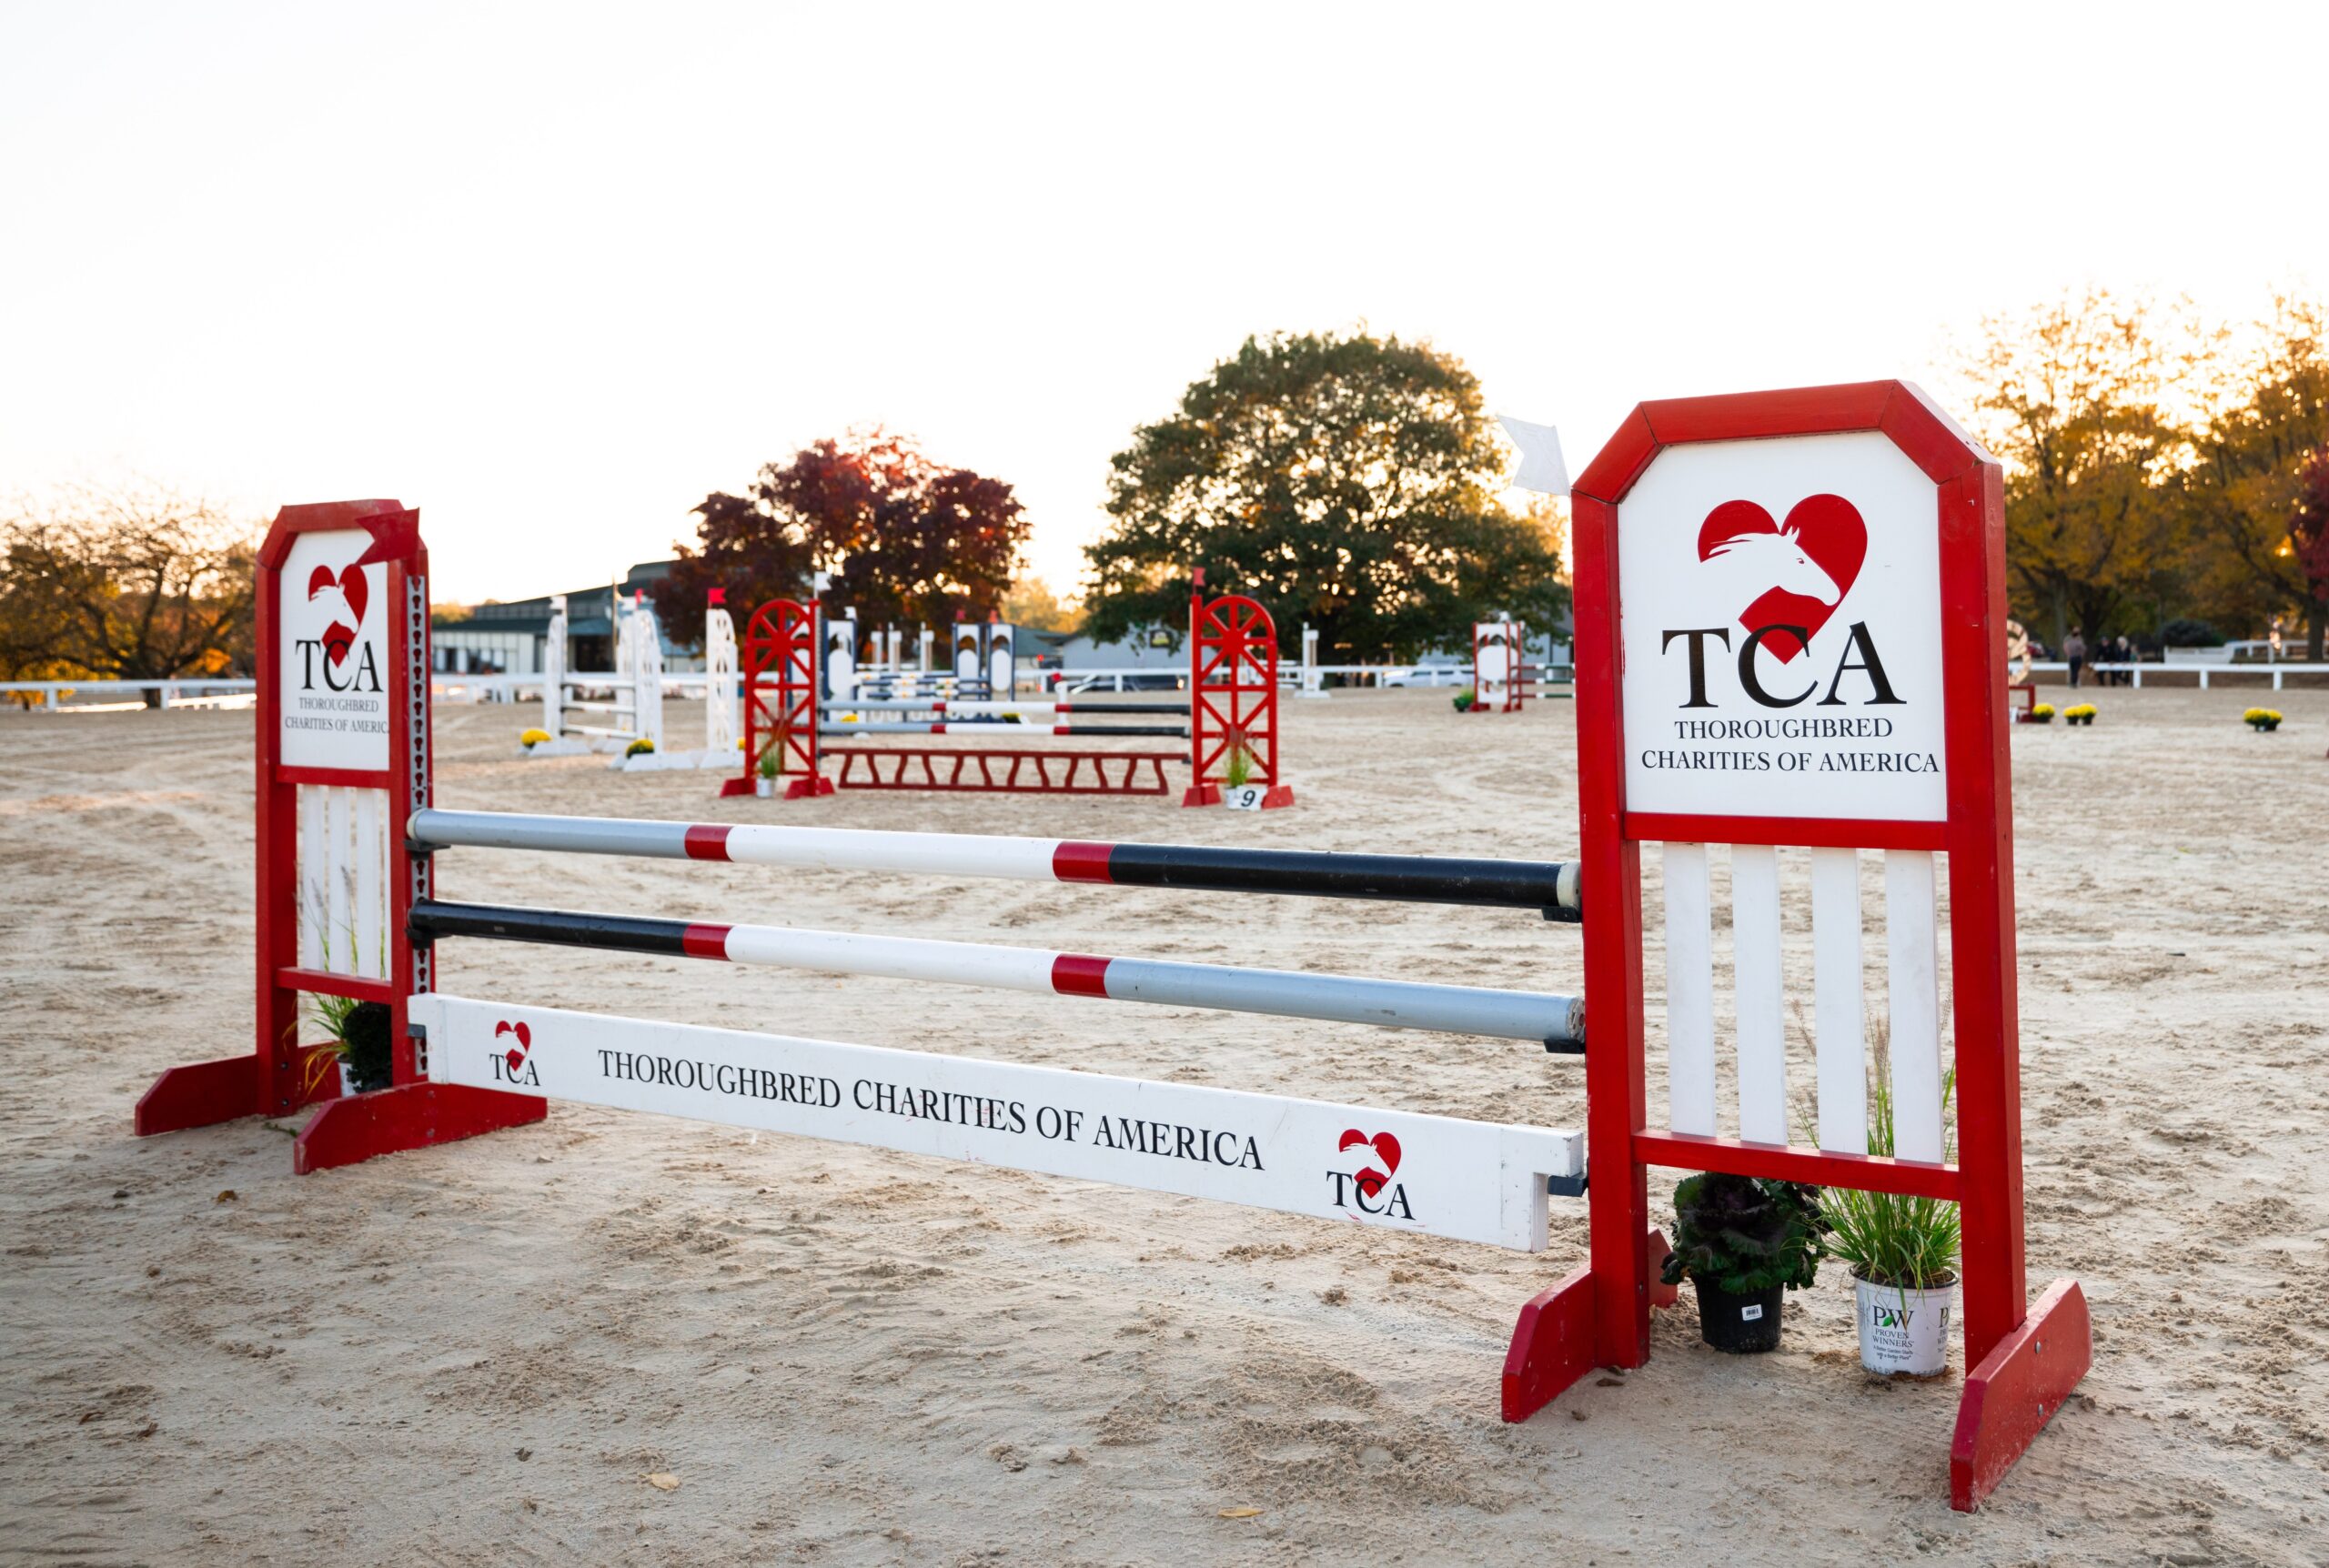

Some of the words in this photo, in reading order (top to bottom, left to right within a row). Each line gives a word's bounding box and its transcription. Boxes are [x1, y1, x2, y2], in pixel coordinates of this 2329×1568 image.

[296, 639, 384, 692] TCA
[1662, 621, 1907, 709] TCA
[298, 697, 379, 712] THOROUGHBRED
[285, 716, 333, 730] CHARITIES
[335, 719, 348, 731] OF
[350, 719, 389, 734] AMERIC
[1674, 718, 1892, 739] THOROUGHBRED
[1641, 750, 1770, 771] CHARITIES
[1777, 752, 1812, 772] OF
[1819, 752, 1940, 773] AMERICA
[1241, 789, 1256, 808] 9
[489, 1053, 540, 1086] TCA
[598, 1050, 841, 1108] THOROUGHBRED
[853, 1079, 1025, 1134] CHARITIES
[1036, 1106, 1084, 1142] OF
[1093, 1115, 1265, 1171] AMERICA
[1326, 1171, 1417, 1221] TCA
[1872, 1305, 1914, 1331] PW
[1872, 1335, 1913, 1348] WINNERS
[1875, 1328, 1910, 1339] PROVEN
